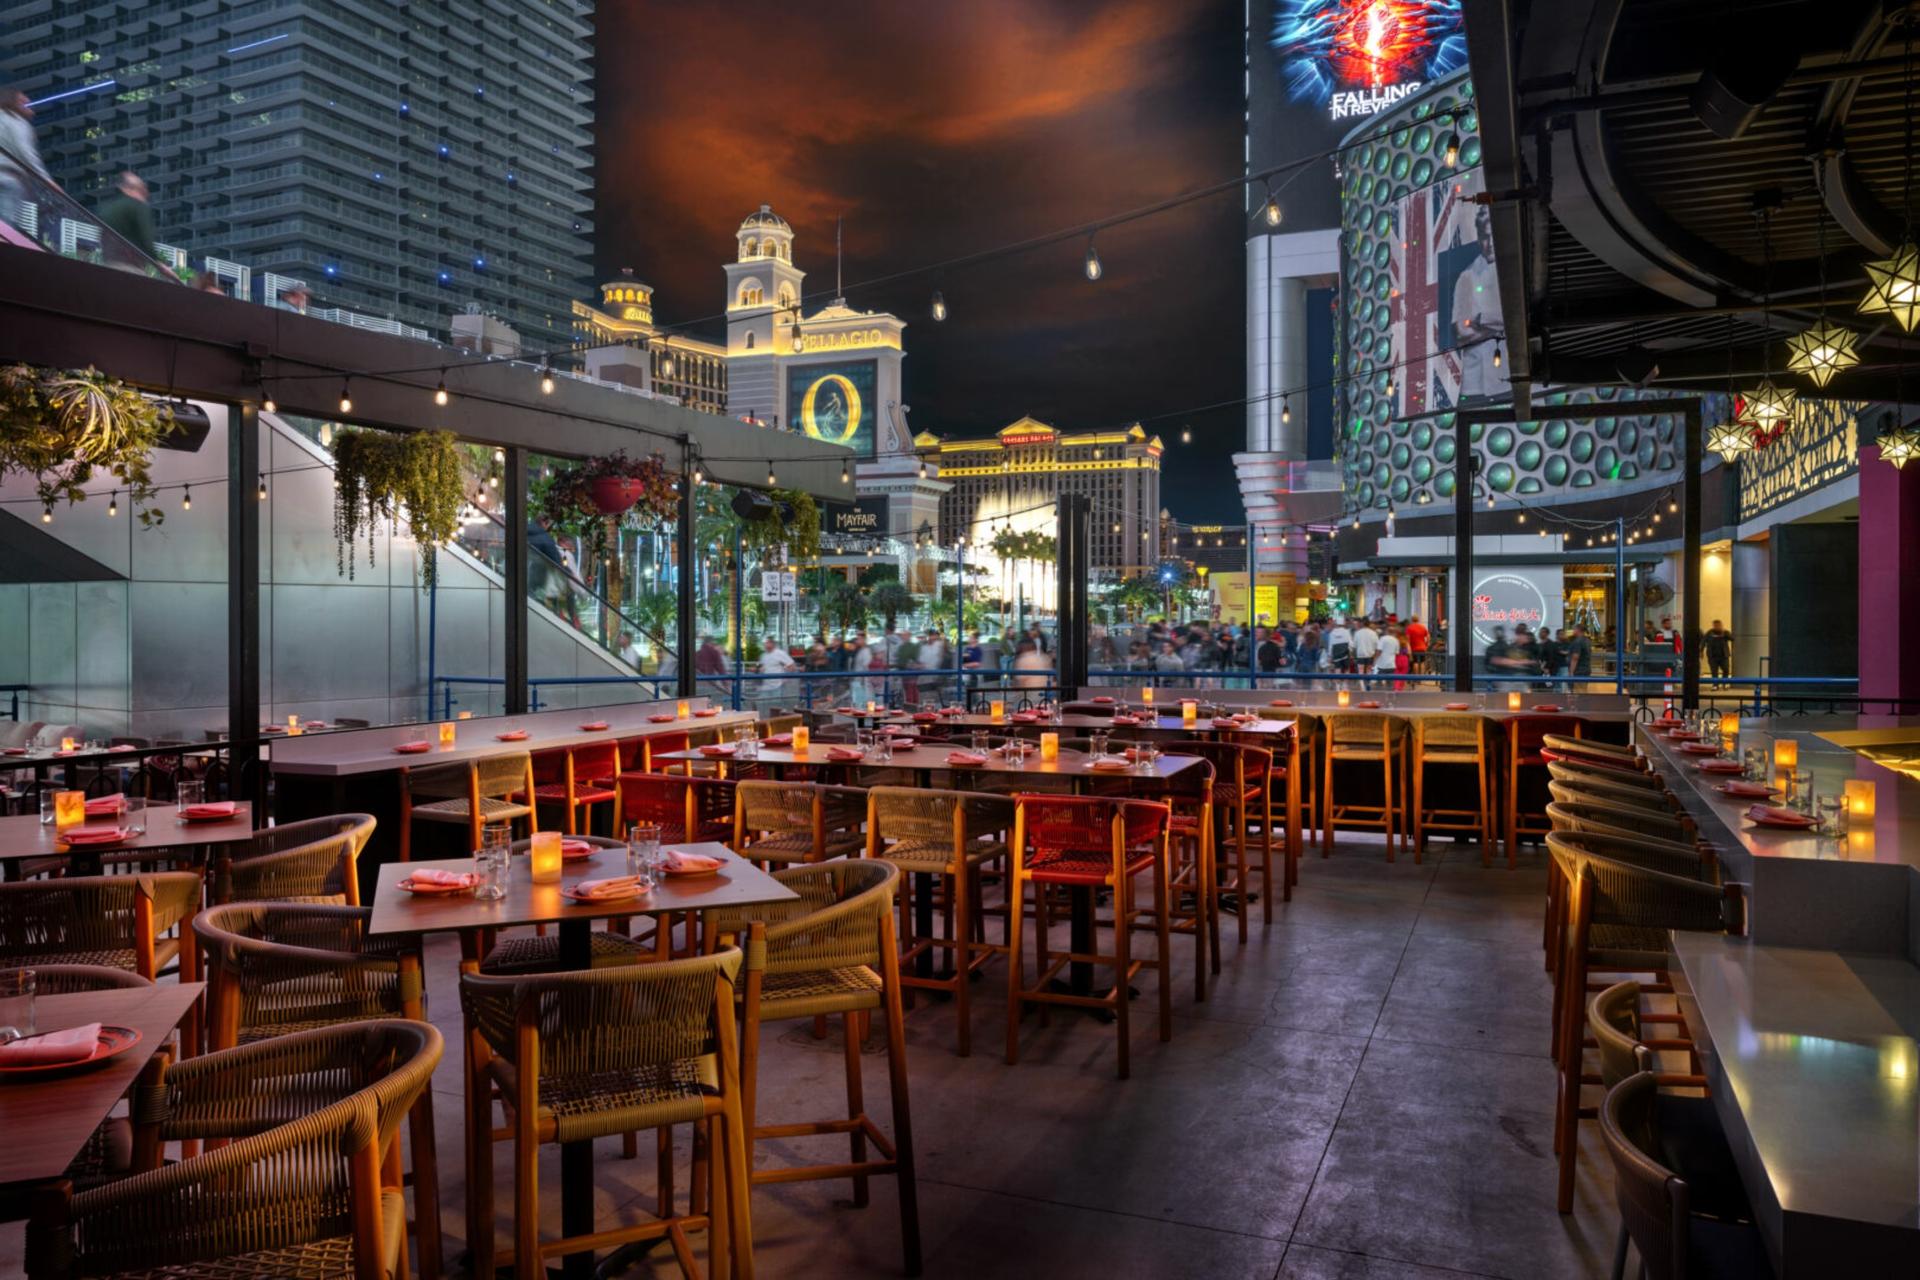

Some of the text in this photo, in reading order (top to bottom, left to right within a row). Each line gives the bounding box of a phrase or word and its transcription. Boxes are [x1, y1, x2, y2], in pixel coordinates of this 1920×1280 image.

[1332, 82, 1421, 106] FALLING
[1350, 101, 1390, 116] REVE
[802, 329, 882, 350] BELLAGIO
[836, 512, 878, 528] MAYFAIR
